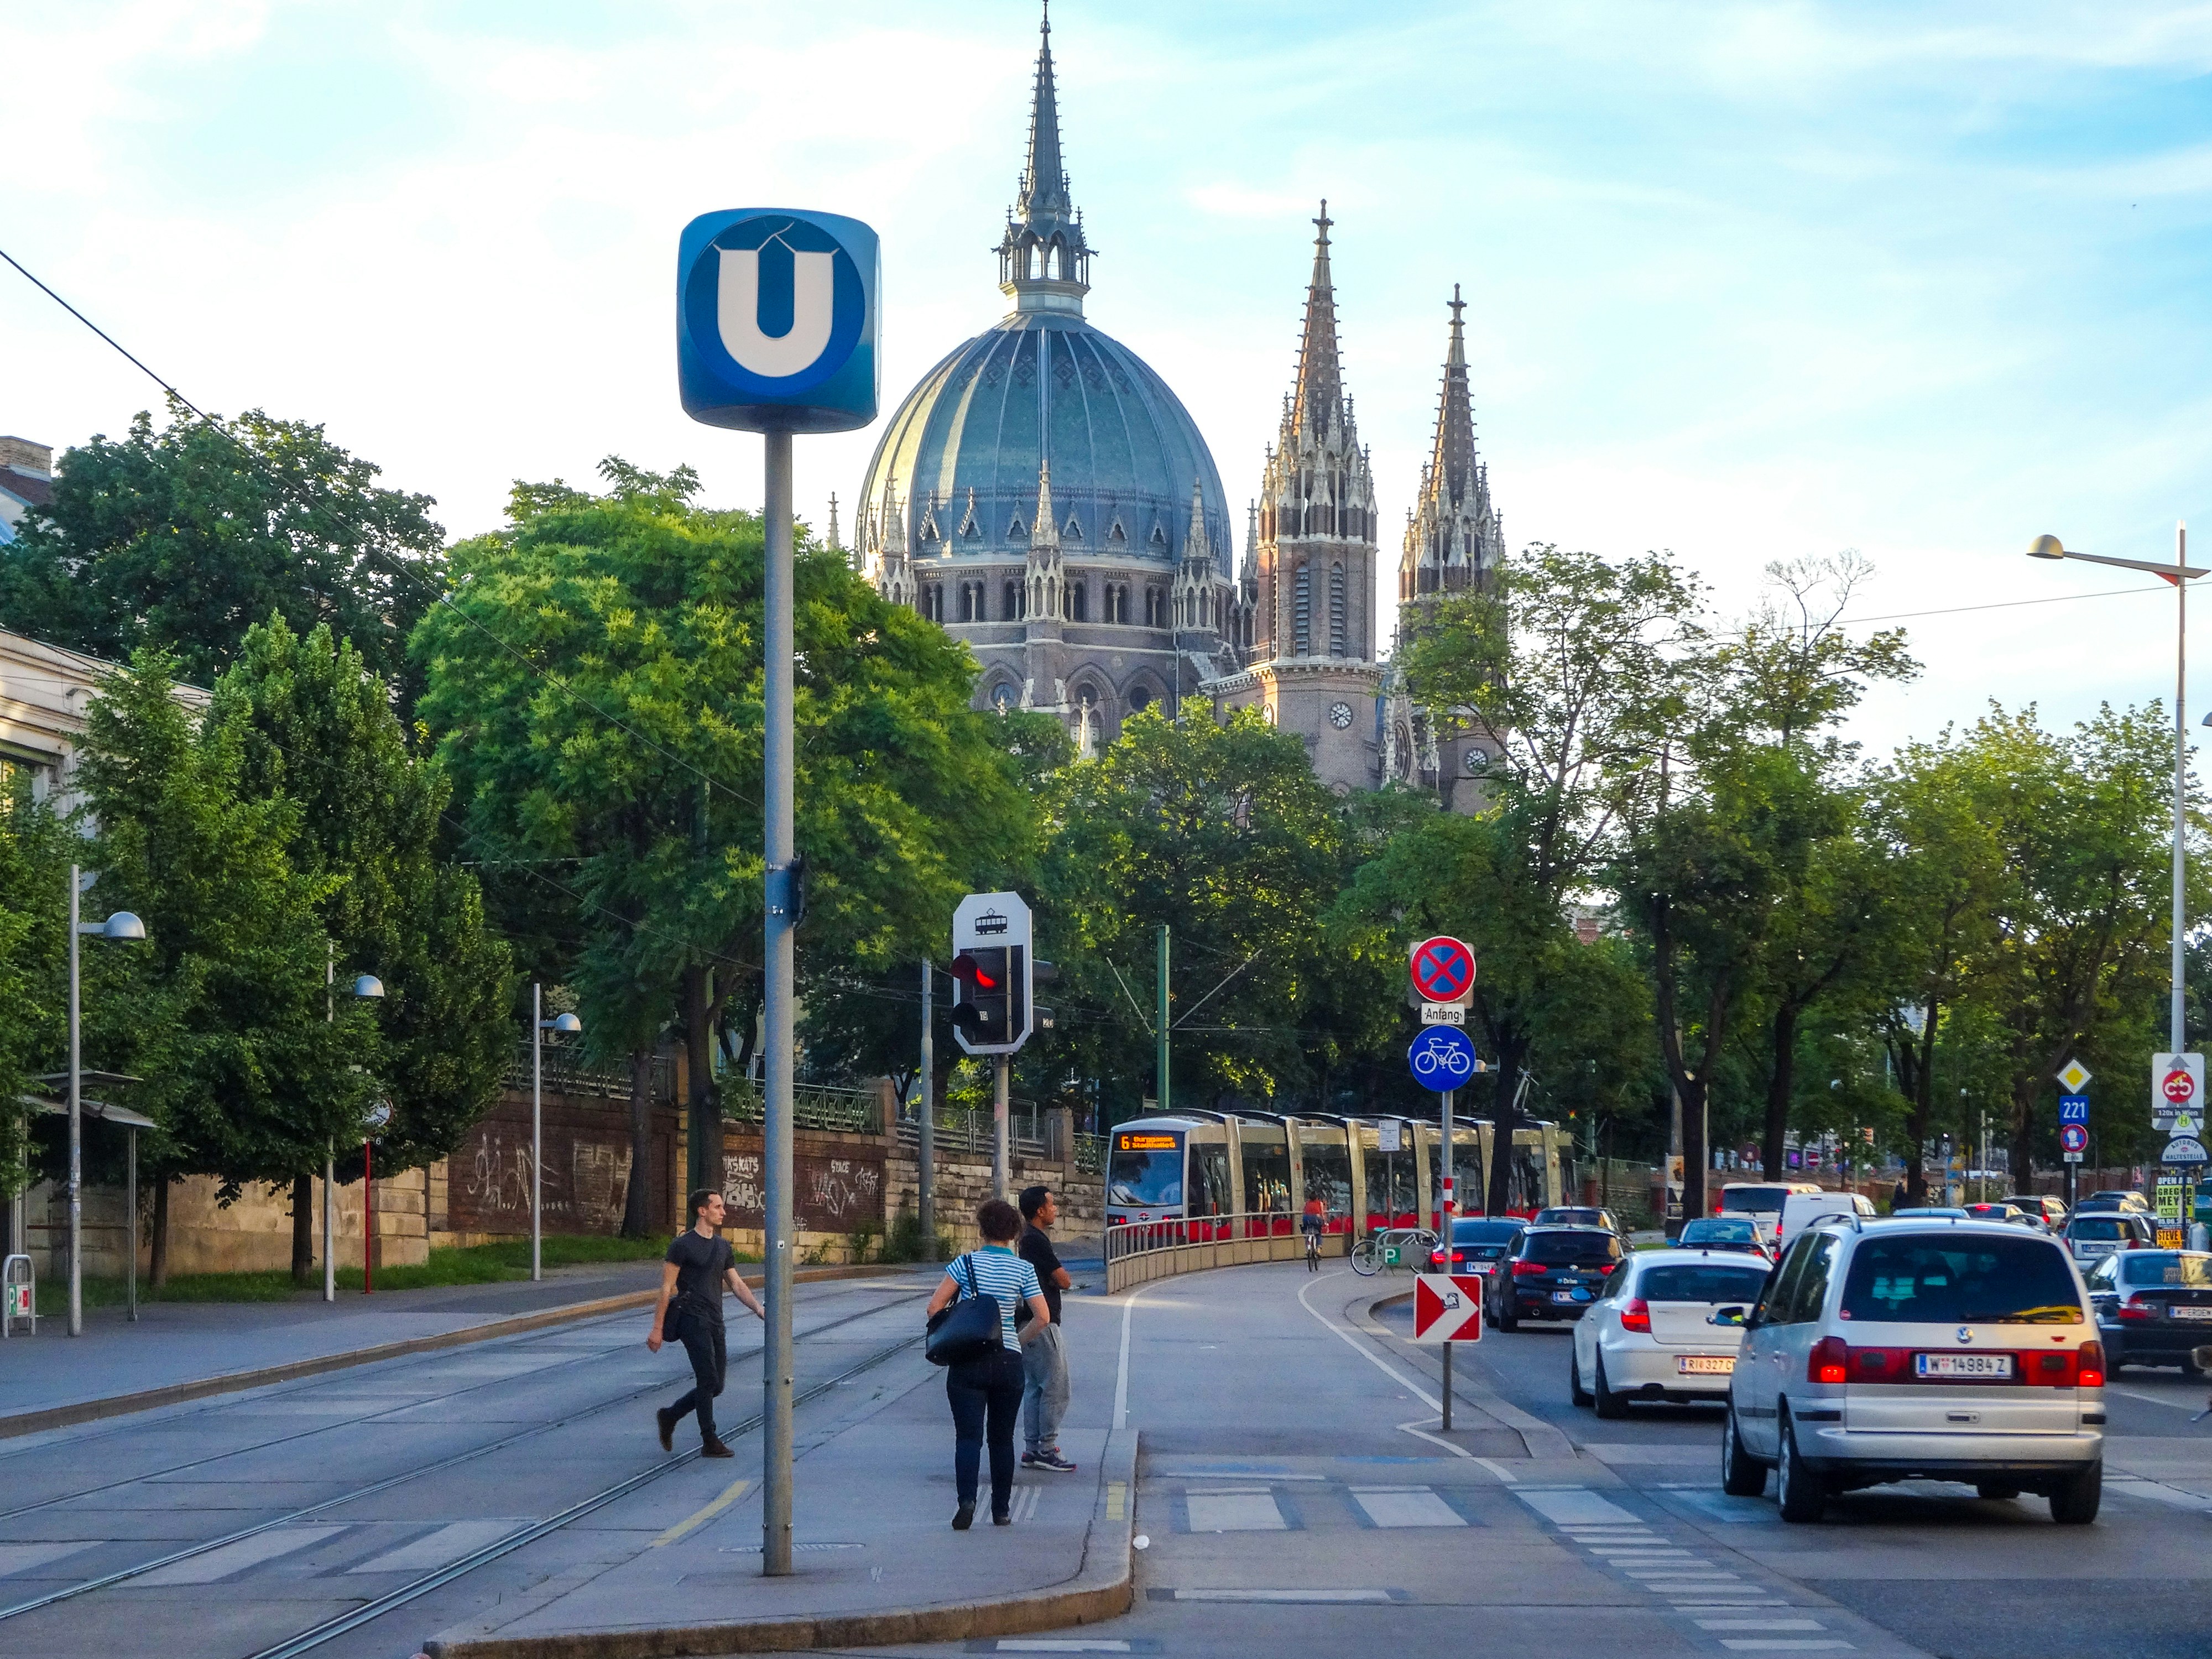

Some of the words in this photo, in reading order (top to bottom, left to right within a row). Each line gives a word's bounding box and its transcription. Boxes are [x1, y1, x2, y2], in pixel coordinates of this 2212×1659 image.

[717, 249, 833, 378] U
[1426, 1008, 1459, 1022] Anfang
[2063, 1102, 2085, 1118] 221
[375, 1137, 382, 1145] 6
[1121, 1136, 1130, 1150] 6
[2171, 1139, 2199, 1150] AUTOBUS
[2158, 1187, 2192, 1196] GREGR
[2158, 1196, 2192, 1206] MEYE
[2158, 1230, 2179, 1240] STEVE
[1385, 1248, 1396, 1264] P
[9, 1287, 15, 1313] P
[1706, 1360, 1724, 1370] 327
[1930, 1358, 1940, 1371] W
[1997, 1358, 2005, 1372] Z
